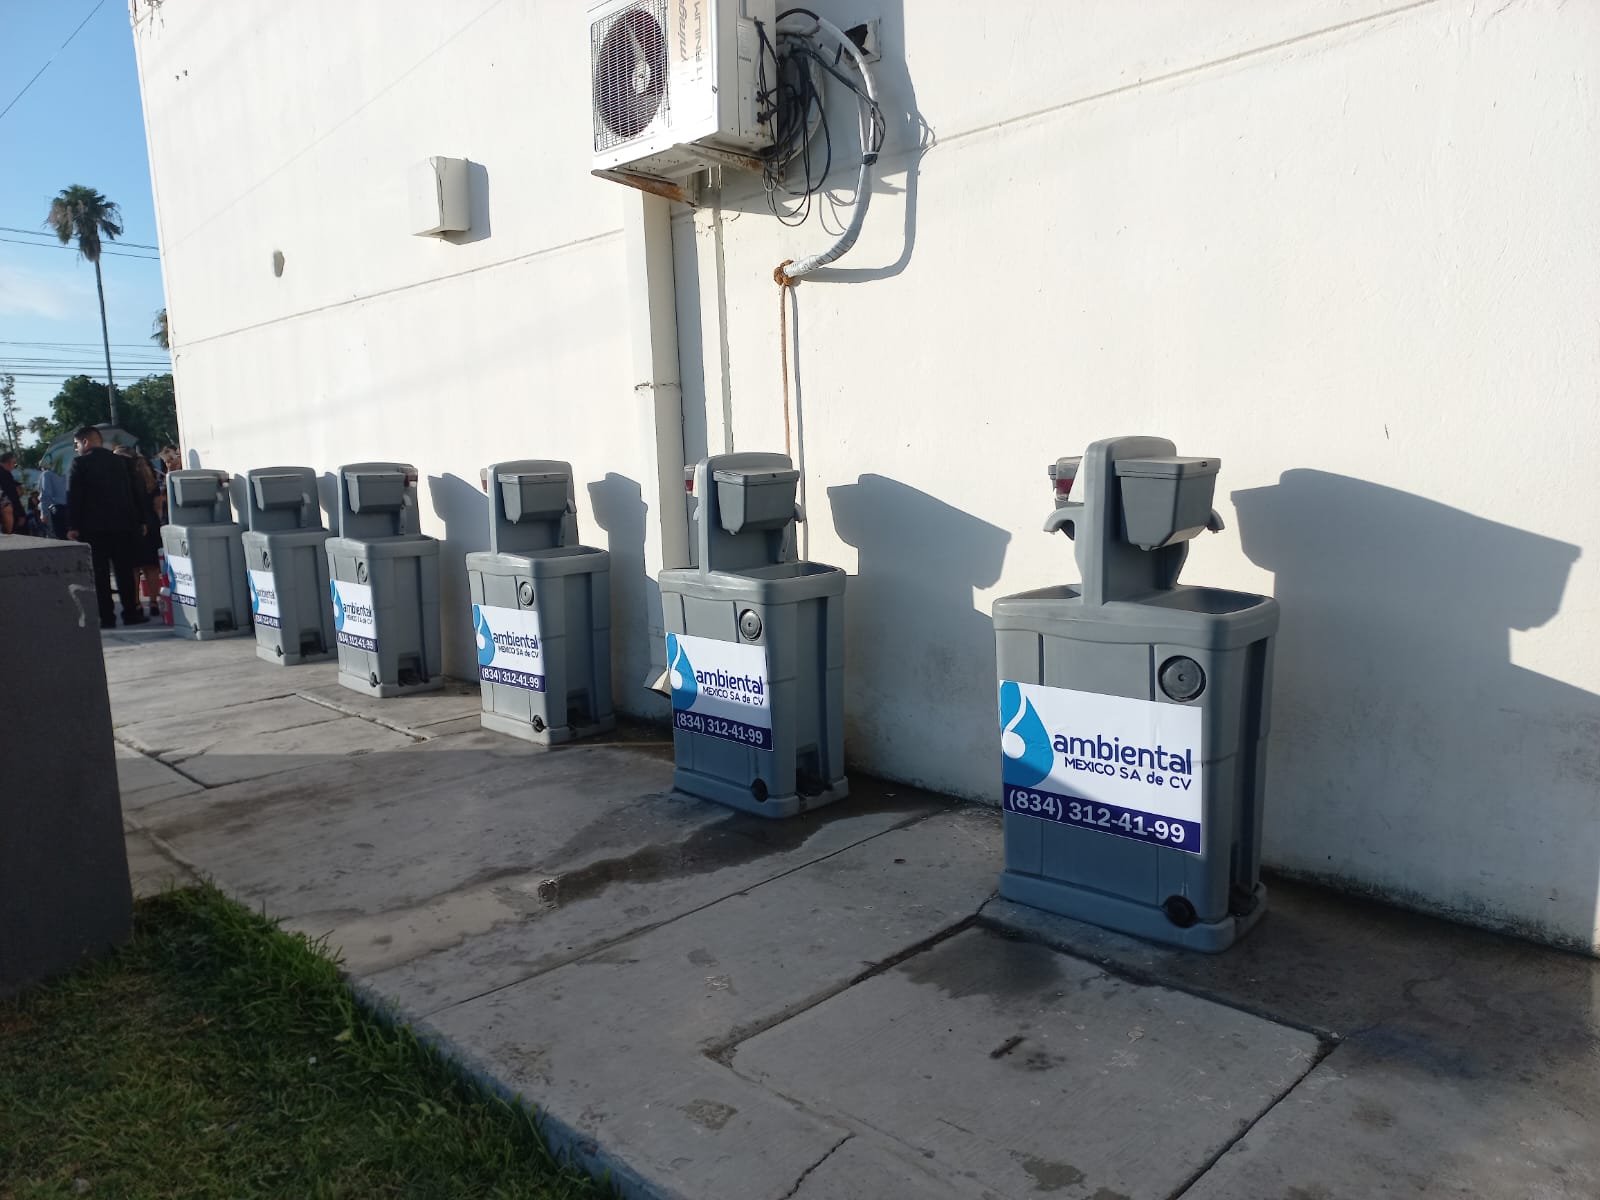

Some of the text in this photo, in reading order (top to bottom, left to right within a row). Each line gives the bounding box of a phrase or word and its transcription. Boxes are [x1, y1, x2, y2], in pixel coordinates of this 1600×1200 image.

[493, 631, 538, 650] ambiental
[482, 667, 539, 688] (834) 312-41-99
[696, 669, 763, 695] ambiental
[703, 686, 764, 706] MEXICO SA de CV
[677, 713, 763, 744] (834) 312-41-99
[1053, 734, 1192, 775] ambiental
[1065, 756, 1192, 790] MEXICO SA de CV
[1010, 789, 1185, 843] (834) 312-41-99
